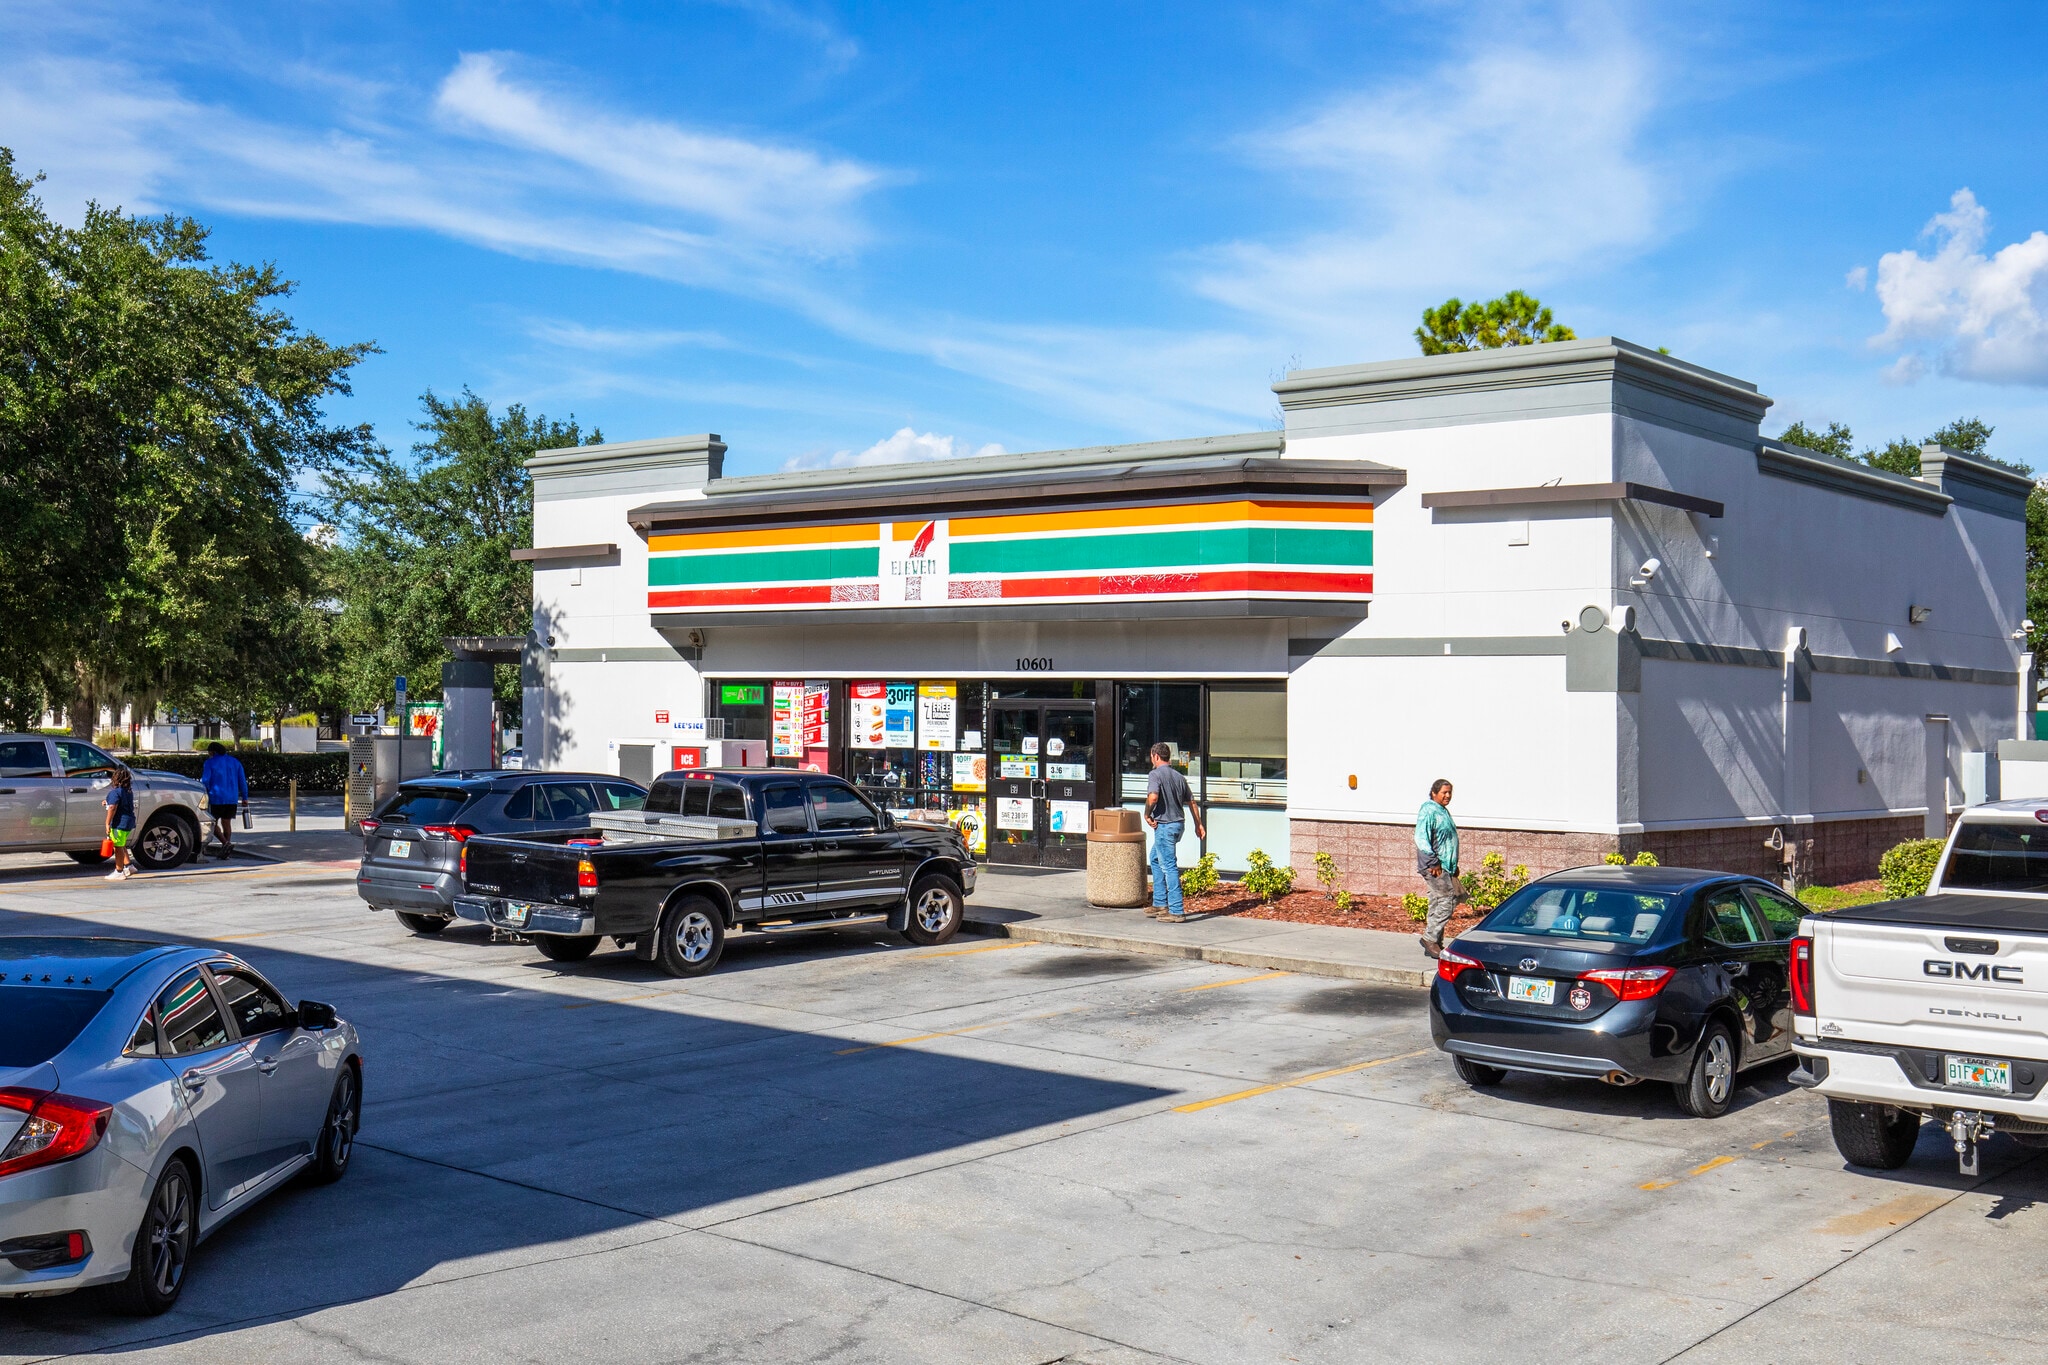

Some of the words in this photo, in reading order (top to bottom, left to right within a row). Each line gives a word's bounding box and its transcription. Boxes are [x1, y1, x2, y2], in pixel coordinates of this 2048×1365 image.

[1016, 657, 1054, 671] 10601
[737, 687, 761, 701] ATM
[897, 688, 915, 702] OFF
[680, 754, 694, 765] ICE
[1923, 959, 2024, 984] GMC
[1929, 1007, 2022, 1021] DENALI
[1966, 1057, 1989, 1065] EAGLE
[1985, 1067, 2007, 1084] CXM
